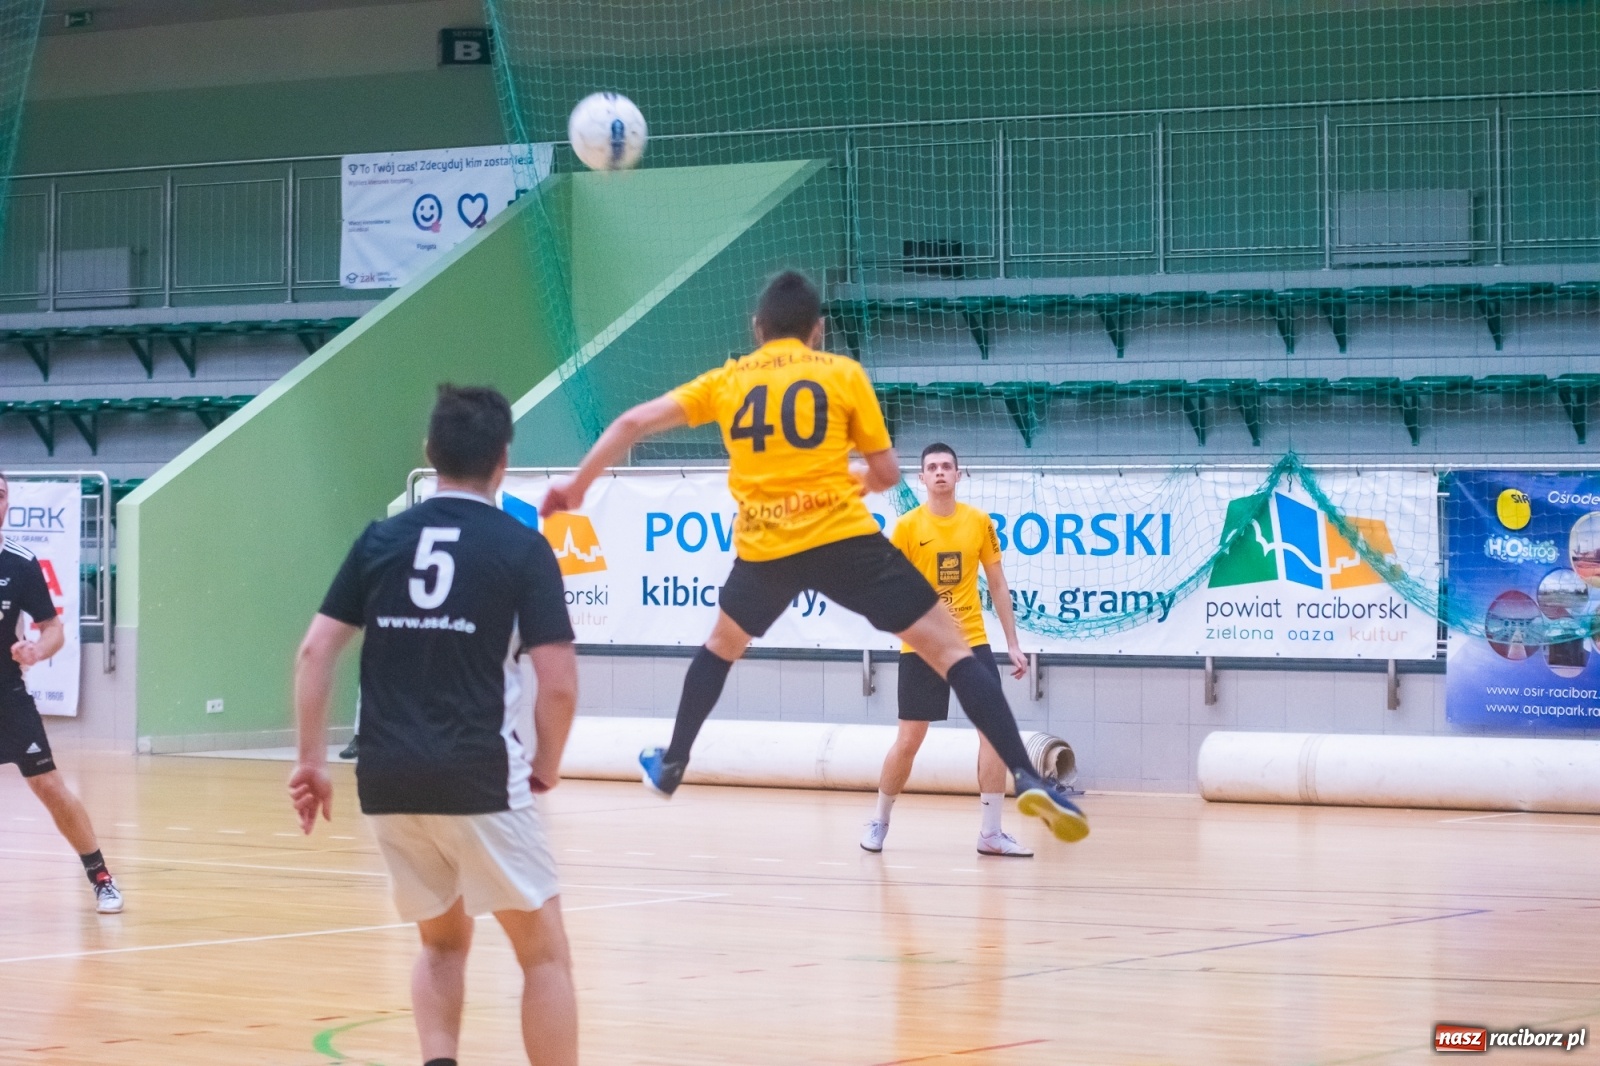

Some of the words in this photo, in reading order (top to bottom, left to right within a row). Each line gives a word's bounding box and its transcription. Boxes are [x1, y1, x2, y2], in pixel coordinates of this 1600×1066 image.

[454, 41, 481, 61] B
[360, 164, 370, 174] To
[373, 163, 395, 176] Twój
[397, 161, 418, 173] czas!
[420, 158, 464, 172] Zdecyduj
[465, 156, 482, 169] kim
[730, 380, 828, 453] 40
[8, 506, 65, 528] ORK
[408, 527, 461, 610] 5
[564, 584, 609, 605] orski
[1059, 587, 1177, 623] gramy
[571, 611, 609, 626] ultur
[949, 605, 972, 613] CTIONS
[1206, 596, 1282, 623] powiat
[1297, 596, 1408, 619] raciborski
[1206, 626, 1274, 640] zielona
[1287, 629, 1335, 641] oaza
[1350, 626, 1408, 642] kultur
